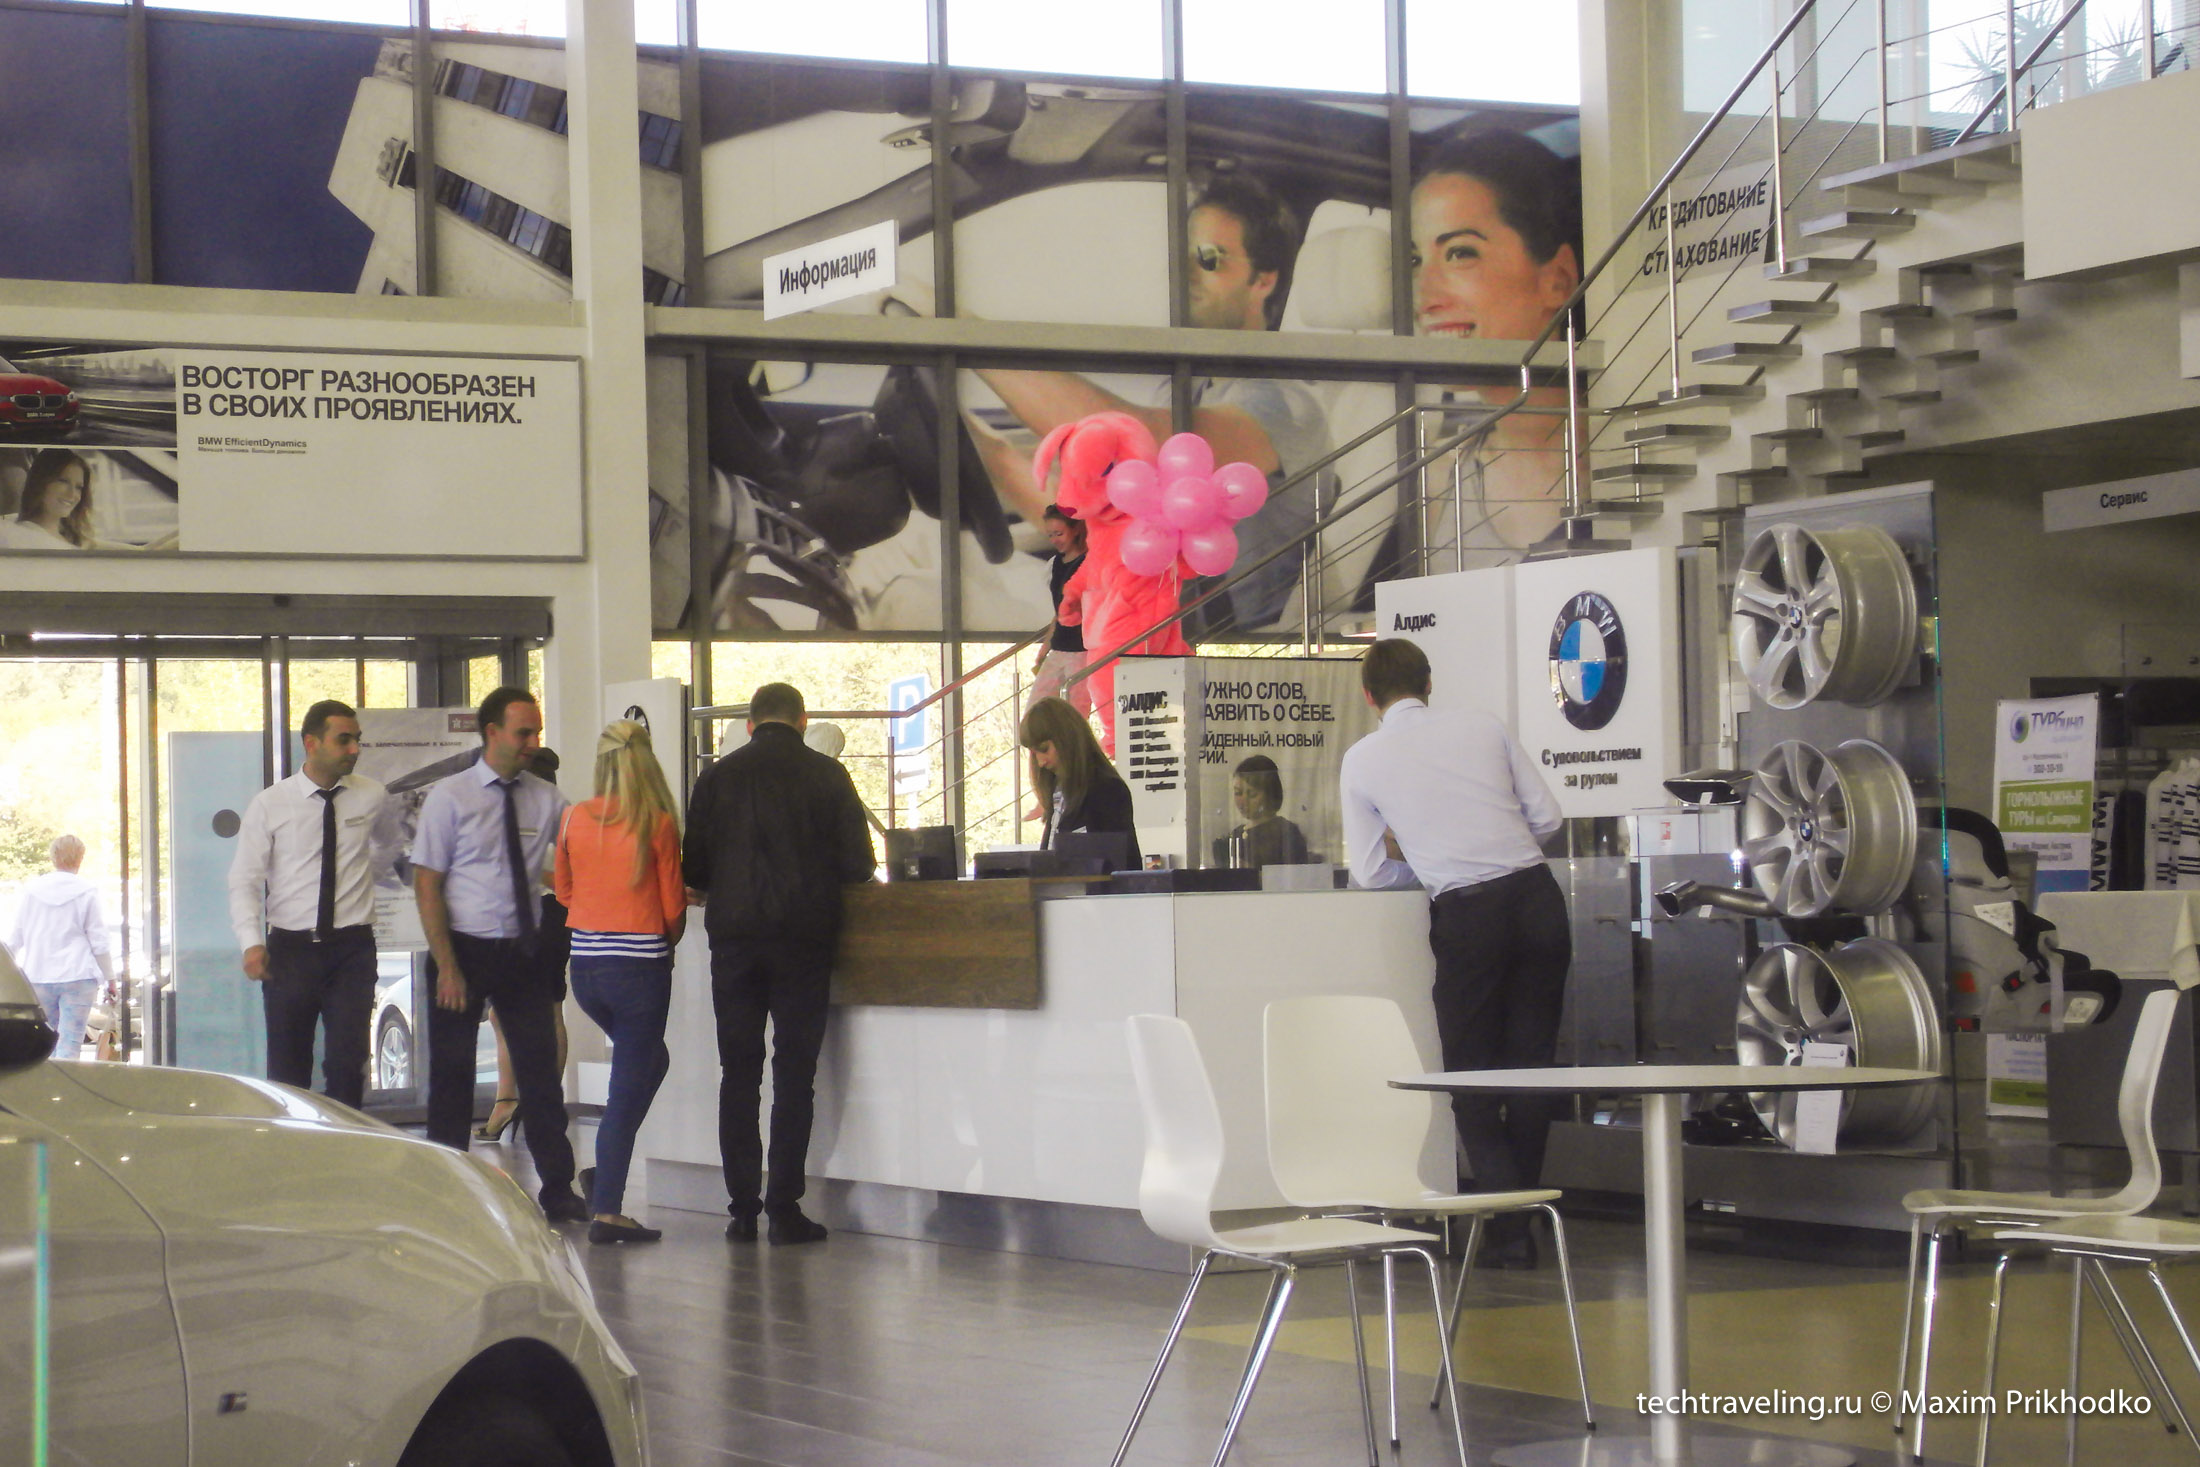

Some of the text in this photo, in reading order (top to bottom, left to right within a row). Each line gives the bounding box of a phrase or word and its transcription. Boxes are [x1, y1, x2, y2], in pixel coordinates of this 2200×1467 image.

[780, 248, 876, 294] Информация
[182, 365, 536, 398] ВОСТОРГ РАЗНООБРАЗЕН
[183, 393, 522, 424] В СВОИХ ПРОЯВЛЕНИЯХ.
[198, 437, 307, 448] BMW EfficientDynamics
[2100, 491, 2148, 509] Сервис
[1393, 613, 1436, 632] Алдис
[1257, 682, 1306, 703] СЛОВ,
[1273, 704, 1285, 721] О
[1289, 704, 1335, 721] СЕБЕ.
[1202, 731, 1324, 749] ЙДЕННЫЙ. НОВЫЙ
[1541, 749, 1550, 766] С
[1564, 775, 1577, 788] за
